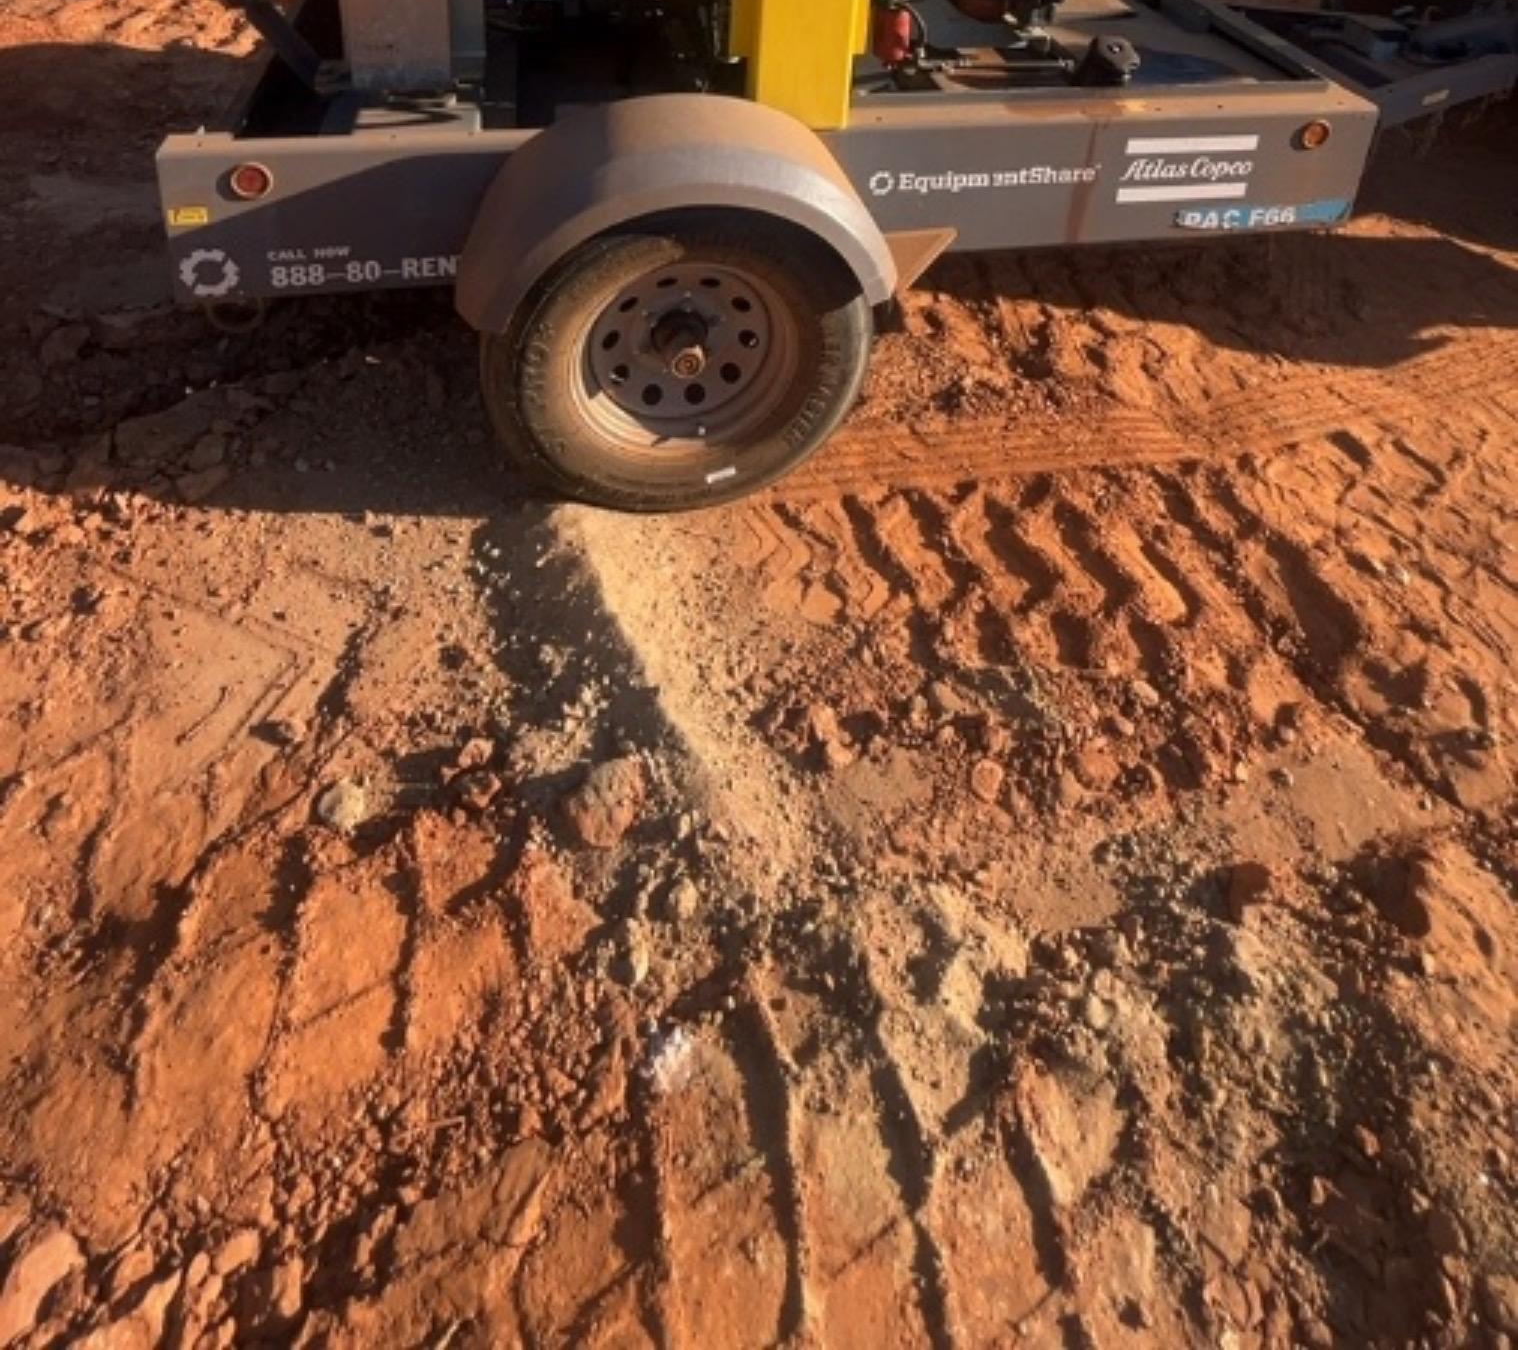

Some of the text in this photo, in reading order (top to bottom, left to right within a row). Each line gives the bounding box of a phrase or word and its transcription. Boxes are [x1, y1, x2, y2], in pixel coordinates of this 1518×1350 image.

[1120, 156, 1253, 181] Atlas Copco
[267, 249, 307, 262] CALL
